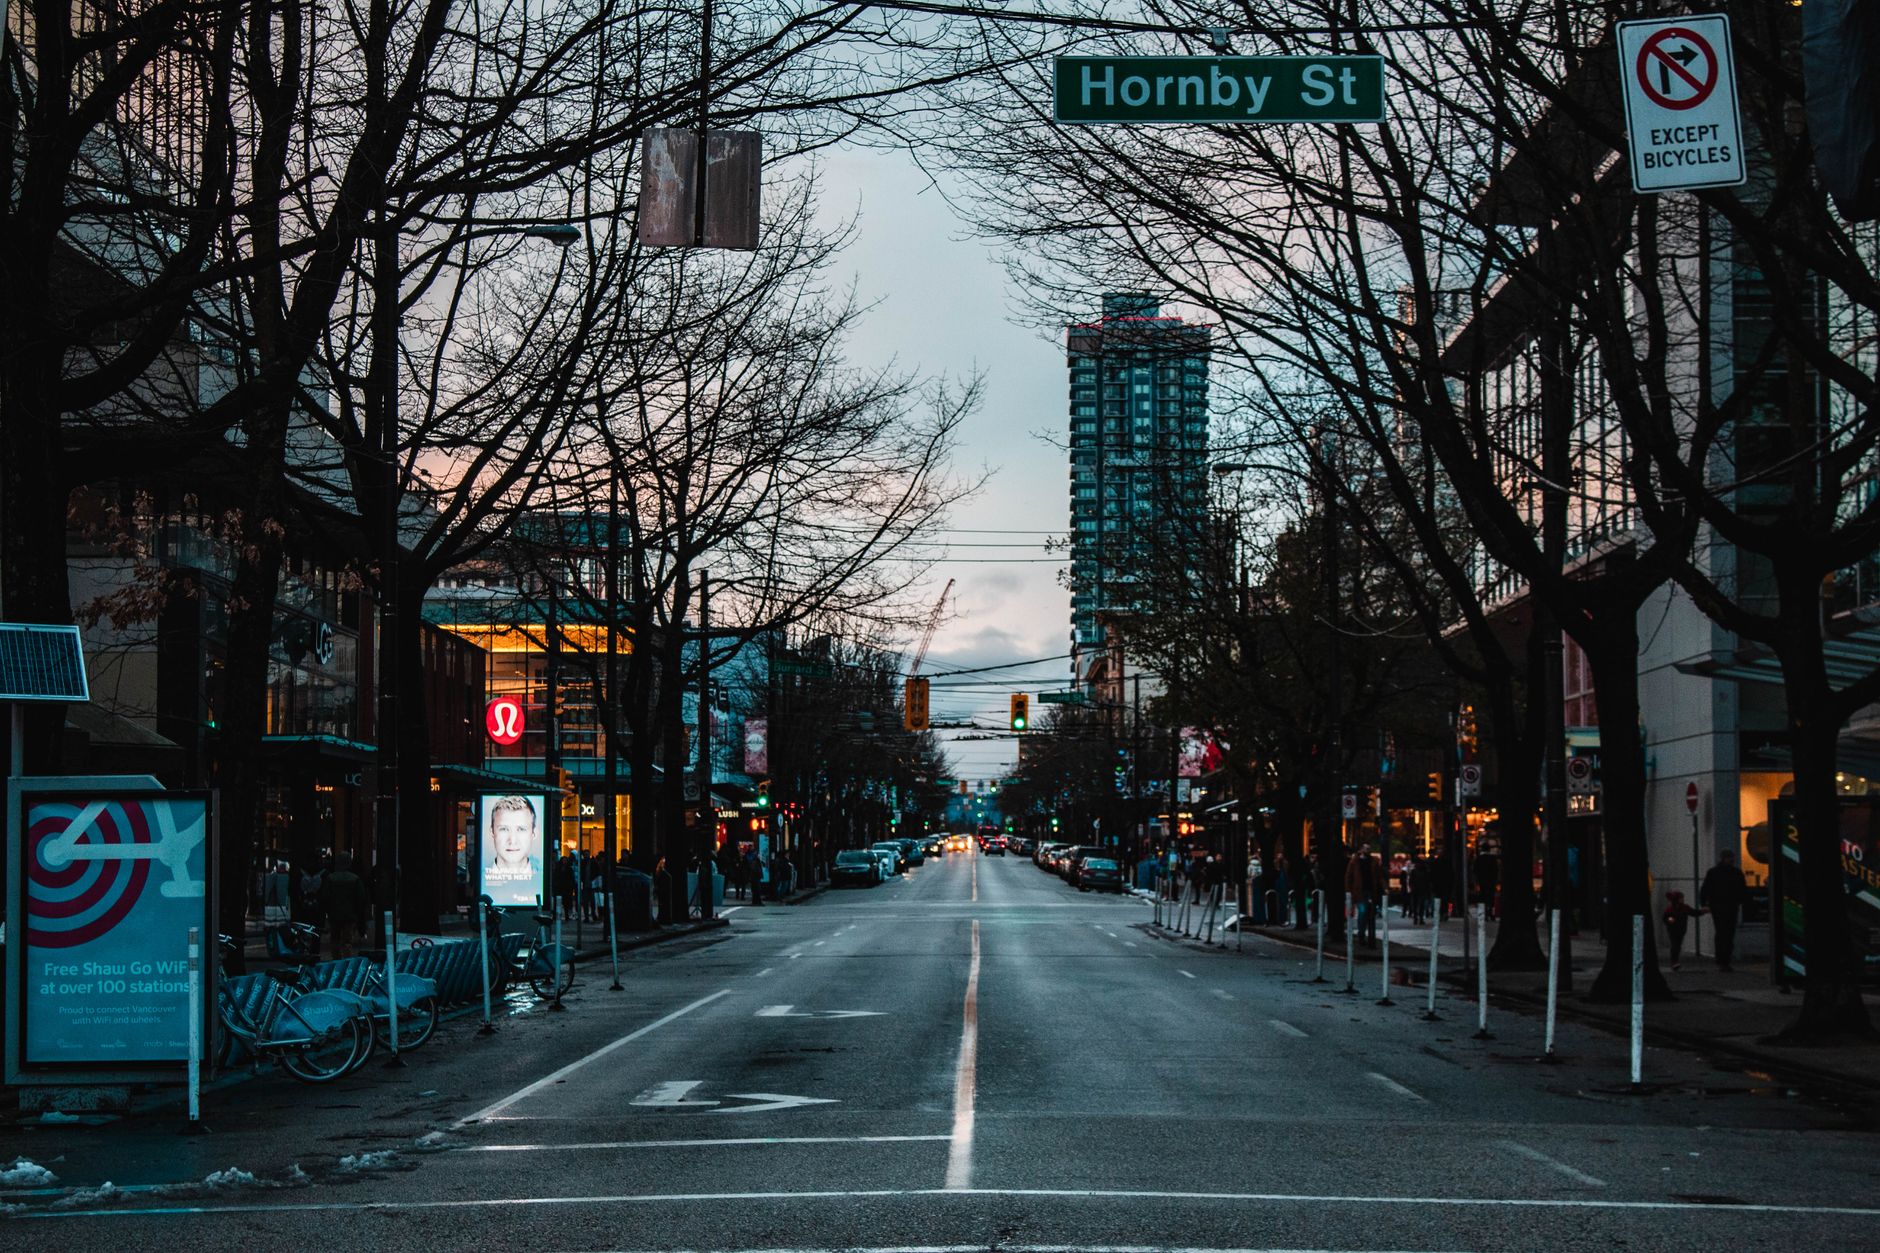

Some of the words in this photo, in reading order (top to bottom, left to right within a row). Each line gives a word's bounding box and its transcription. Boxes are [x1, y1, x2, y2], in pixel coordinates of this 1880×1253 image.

[1081, 65, 1272, 115] Hornby
[1301, 63, 1357, 106] St
[1651, 124, 1720, 146] EXCEPT
[1643, 145, 1732, 169] BICYCLES
[717, 810, 740, 819] LUSH
[1842, 838, 1864, 862] TO
[44, 962, 78, 976] Free
[82, 961, 126, 976] Shaw
[130, 961, 153, 975] Go
[156, 960, 188, 974] WiF
[40, 981, 56, 995] at
[59, 983, 94, 994] over
[98, 980, 126, 994] 100
[129, 979, 190, 993] stations
[59, 1006, 84, 1015] Proud
[86, 1006, 95, 1014] to
[97, 1006, 130, 1014] connect
[132, 1005, 177, 1014] Vancouver
[72, 1017, 91, 1025] with
[93, 1016, 111, 1025] WiFi
[113, 1016, 129, 1024] and
